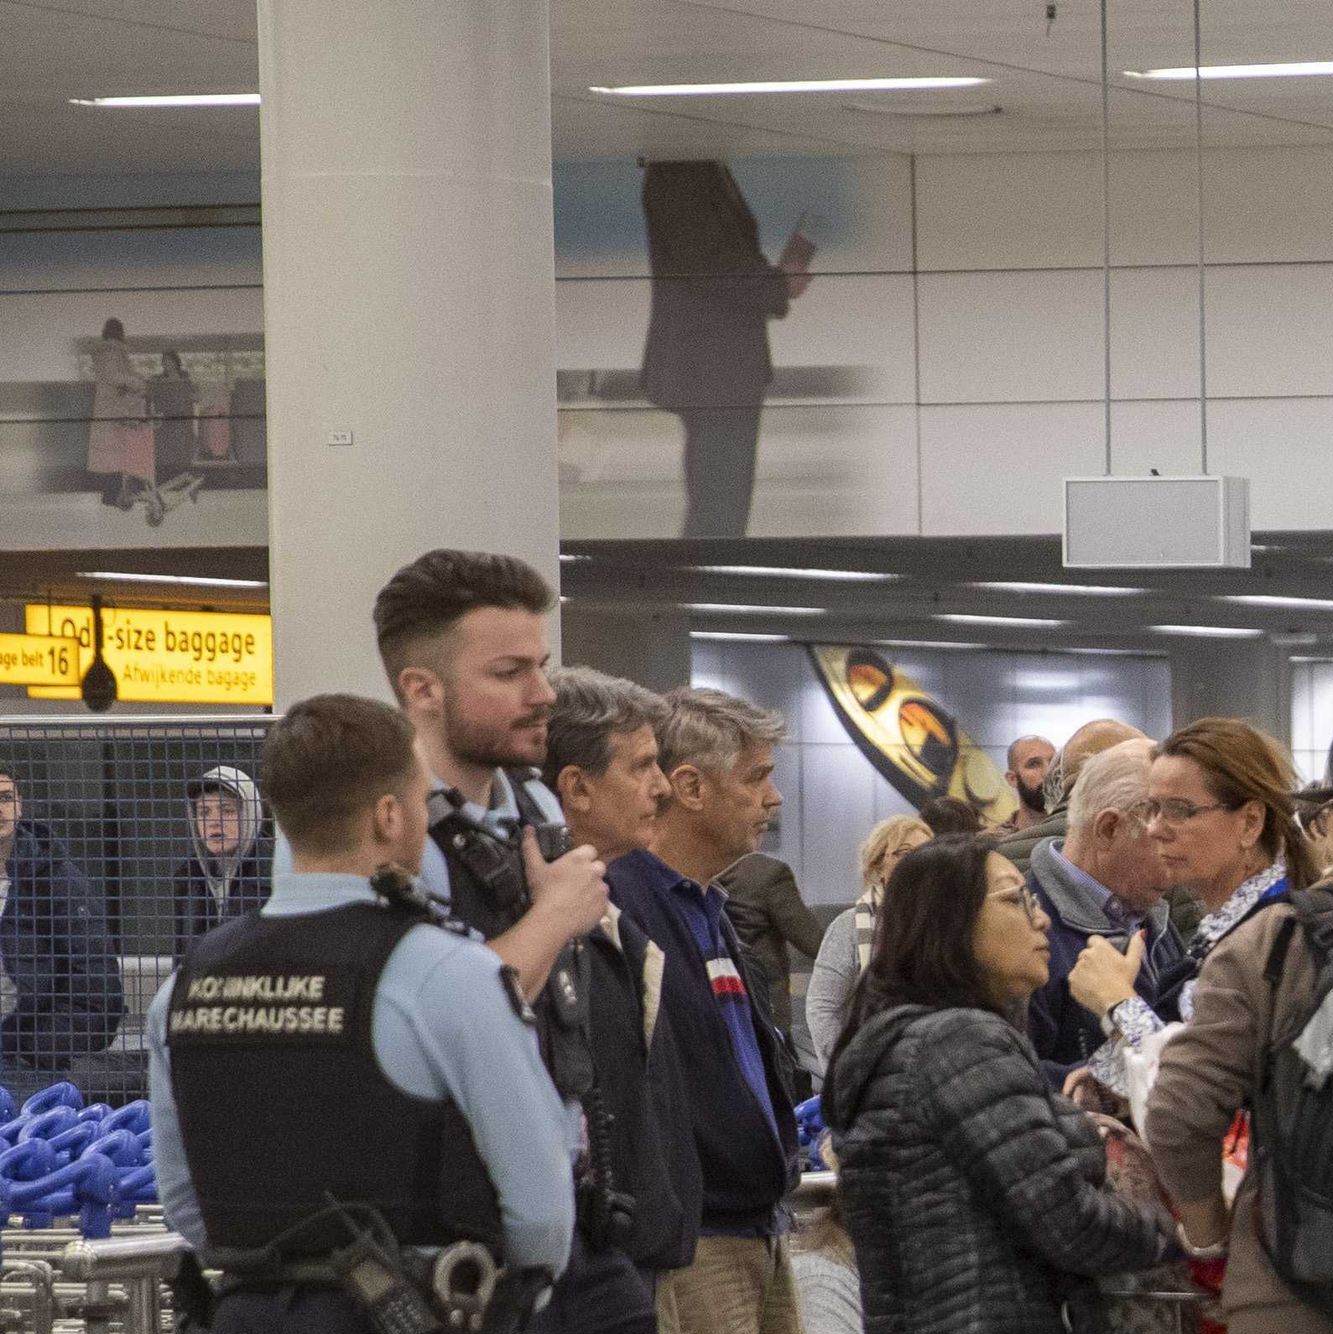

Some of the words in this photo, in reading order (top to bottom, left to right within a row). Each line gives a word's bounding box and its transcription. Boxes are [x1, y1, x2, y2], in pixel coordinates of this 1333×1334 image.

[164, 620, 255, 663] baggage
[21, 649, 44, 669] belt
[48, 646, 69, 676] 16
[206, 667, 256, 692] bagage
